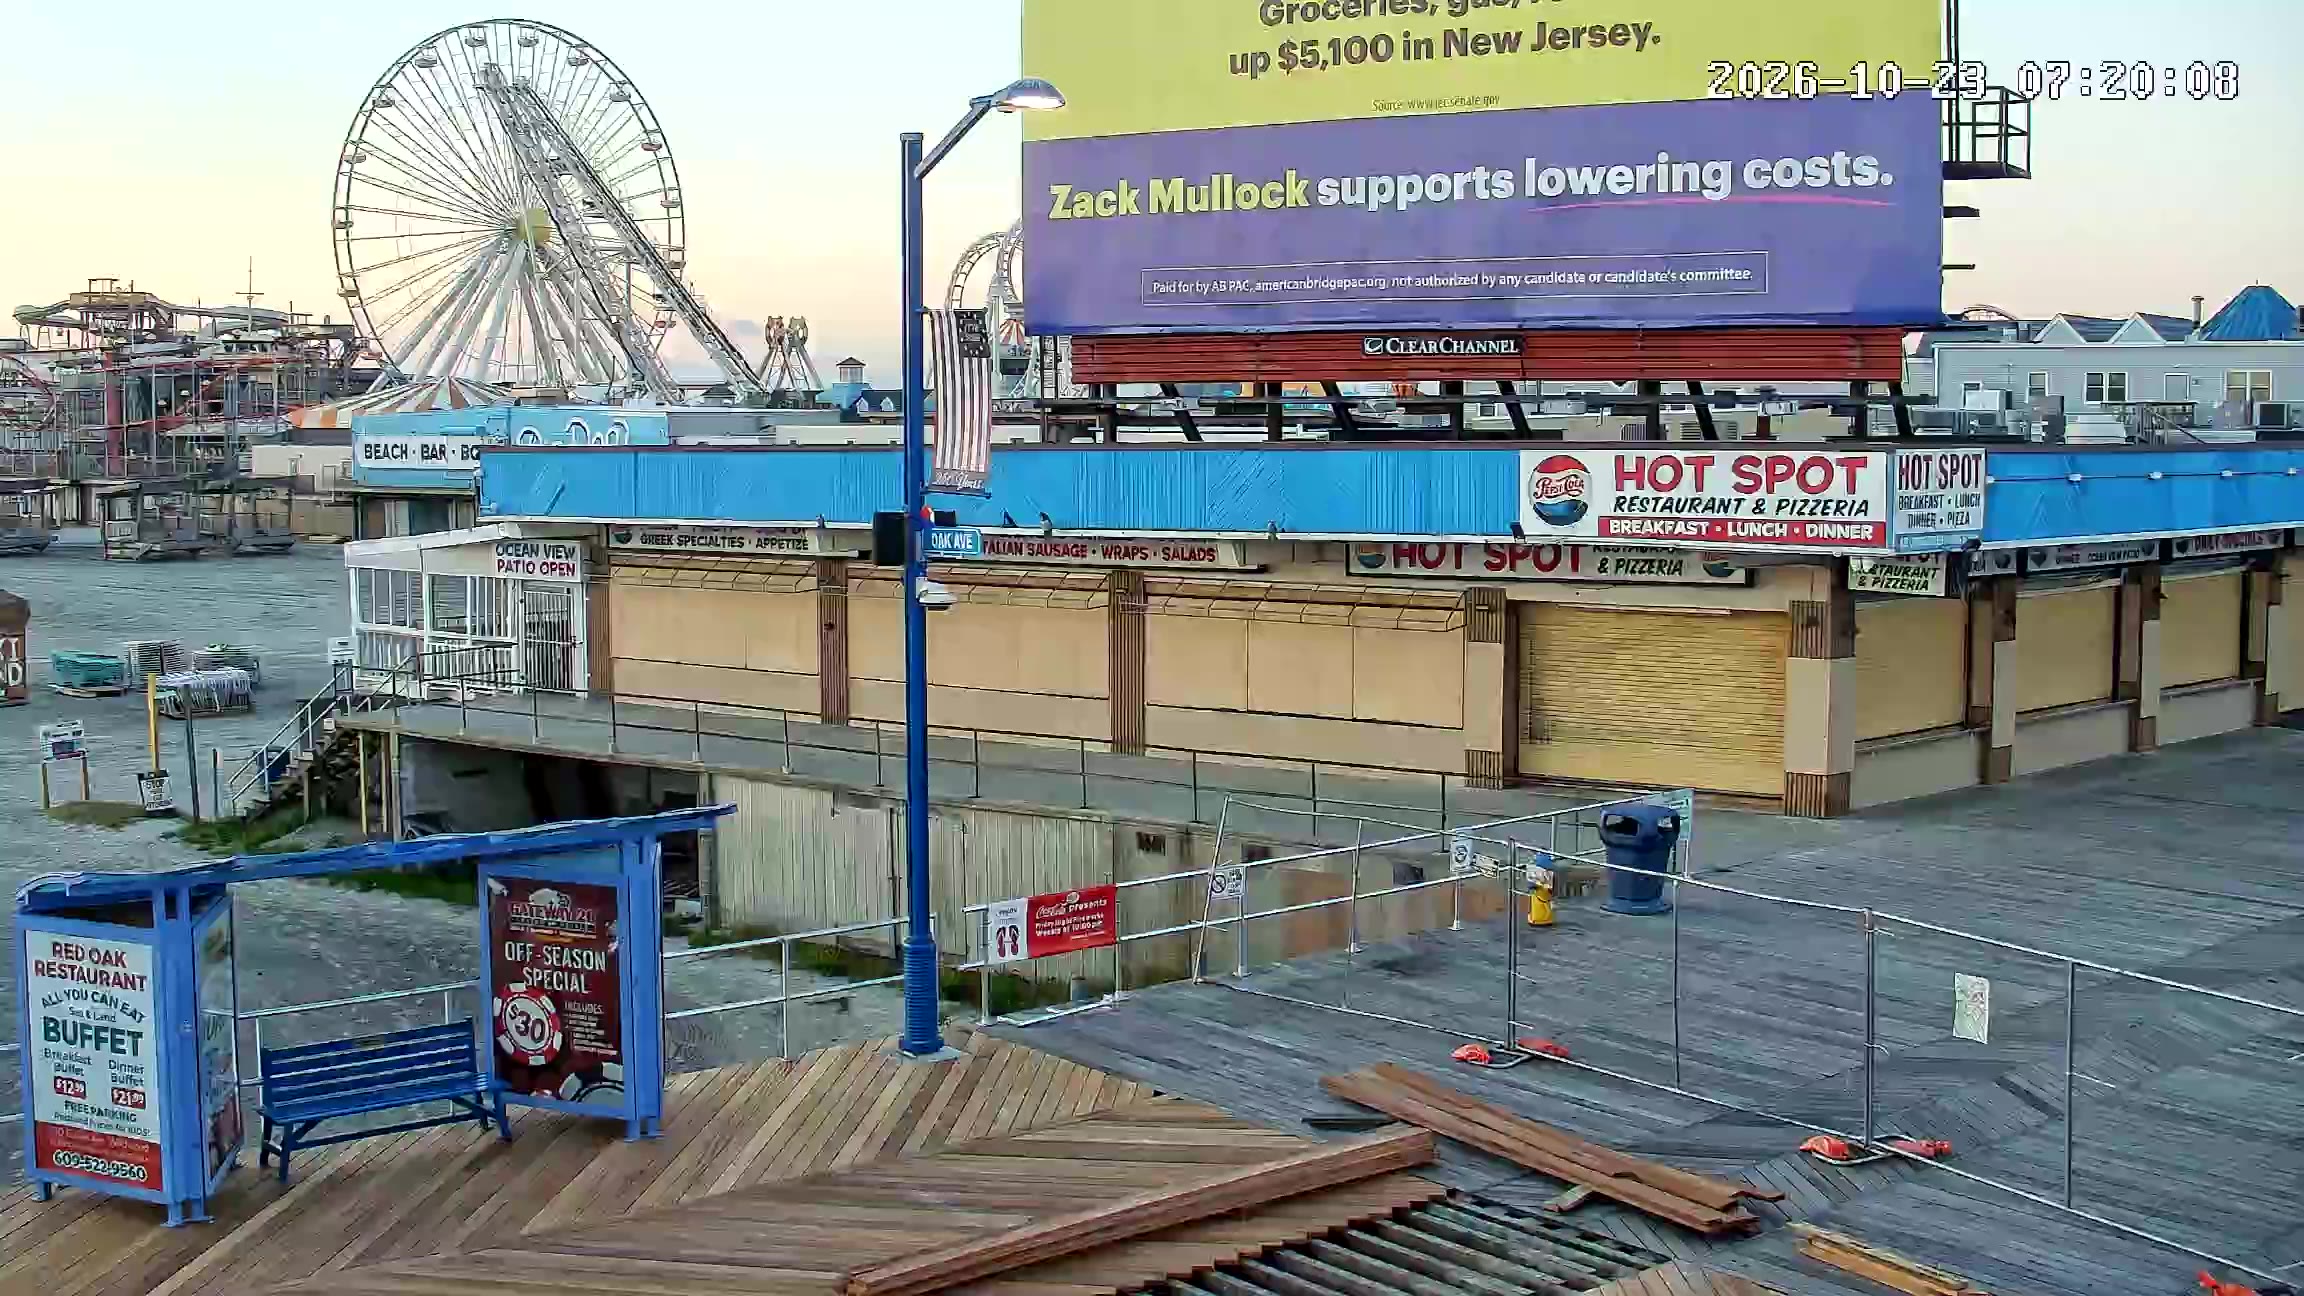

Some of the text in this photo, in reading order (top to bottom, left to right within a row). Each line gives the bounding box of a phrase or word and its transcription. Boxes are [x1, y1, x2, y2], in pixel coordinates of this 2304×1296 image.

[1229, 21, 1661, 80] up $5,100 in New Jersey.
[1048, 150, 1896, 220] Zack Mullock supports lowering costs.
[1152, 280, 1177, 294] Paid
[1178, 280, 1195, 293] for
[1196, 280, 1210, 297] by
[1391, 275, 1413, 288] not
[1414, 273, 1479, 288] authorized
[1481, 272, 1496, 289] by
[1499, 273, 1521, 288] any
[1524, 270, 1586, 284] candidate
[1588, 272, 1602, 283] or
[1604, 266, 1677, 283] candidate's
[1679, 267, 1753, 282] committee.
[364, 443, 408, 461] BEACH
[420, 444, 448, 460] BAR
[1614, 454, 1868, 495] HOT SPOT
[1898, 453, 1983, 491] HOT SPOT
[1612, 495, 1869, 518] RESTAURANT & PIZZERIA
[1898, 493, 1981, 510] BREAKFAST LUNCH
[1609, 519, 1873, 541] BREAKFAST LUNCH DINNER
[1908, 511, 1970, 529] DINNER PIZZA
[495, 543, 576, 559] OCEAN VIEW
[640, 532, 674, 546] GREEK
[676, 534, 745, 549] SPECIALTIES
[931, 532, 973, 549] OAK AVE
[1027, 541, 1088, 558] SAUSAGE
[1100, 544, 1149, 561] WRAPS
[1161, 545, 1217, 563] SALADS
[497, 558, 576, 577] PATIO OPEN
[1393, 543, 1583, 573] HOT SPOT
[1597, 557, 1684, 576] & PIZZERIA
[1858, 575, 1930, 591] & PIZZERIA
[52, 942, 127, 968] RED OAK
[504, 941, 606, 973] OFF-SEASON
[34, 959, 147, 992] RESTAURANT
[523, 967, 592, 994] SPECIAL
[41, 988, 147, 1023] ALL YOU CAN EAT
[43, 1015, 144, 1057] BUFFET
[54, 1062, 84, 1076] Buffet
[108, 1060, 144, 1075] Dinner
[111, 1073, 144, 1086] Buffet
[65, 1100, 89, 1114] FREE
[90, 1106, 137, 1123] PARKING
[53, 1149, 148, 1182] 609-522-9560
